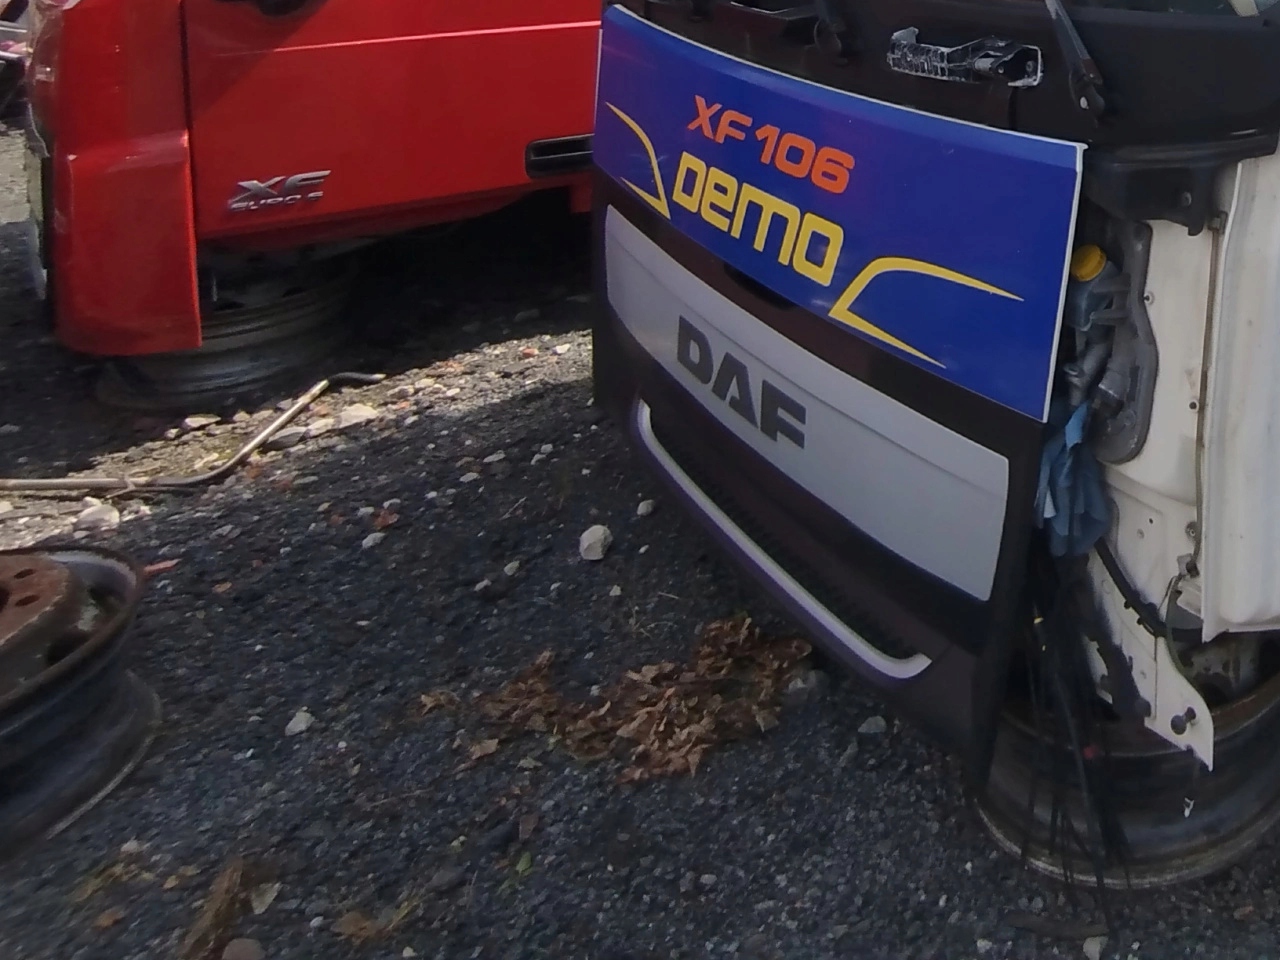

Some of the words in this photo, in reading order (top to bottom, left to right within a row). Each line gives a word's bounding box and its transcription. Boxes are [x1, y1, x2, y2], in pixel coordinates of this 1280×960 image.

[228, 169, 331, 204] XF
[687, 94, 754, 144] XF
[755, 124, 856, 194] 106
[677, 315, 807, 450] DAF
